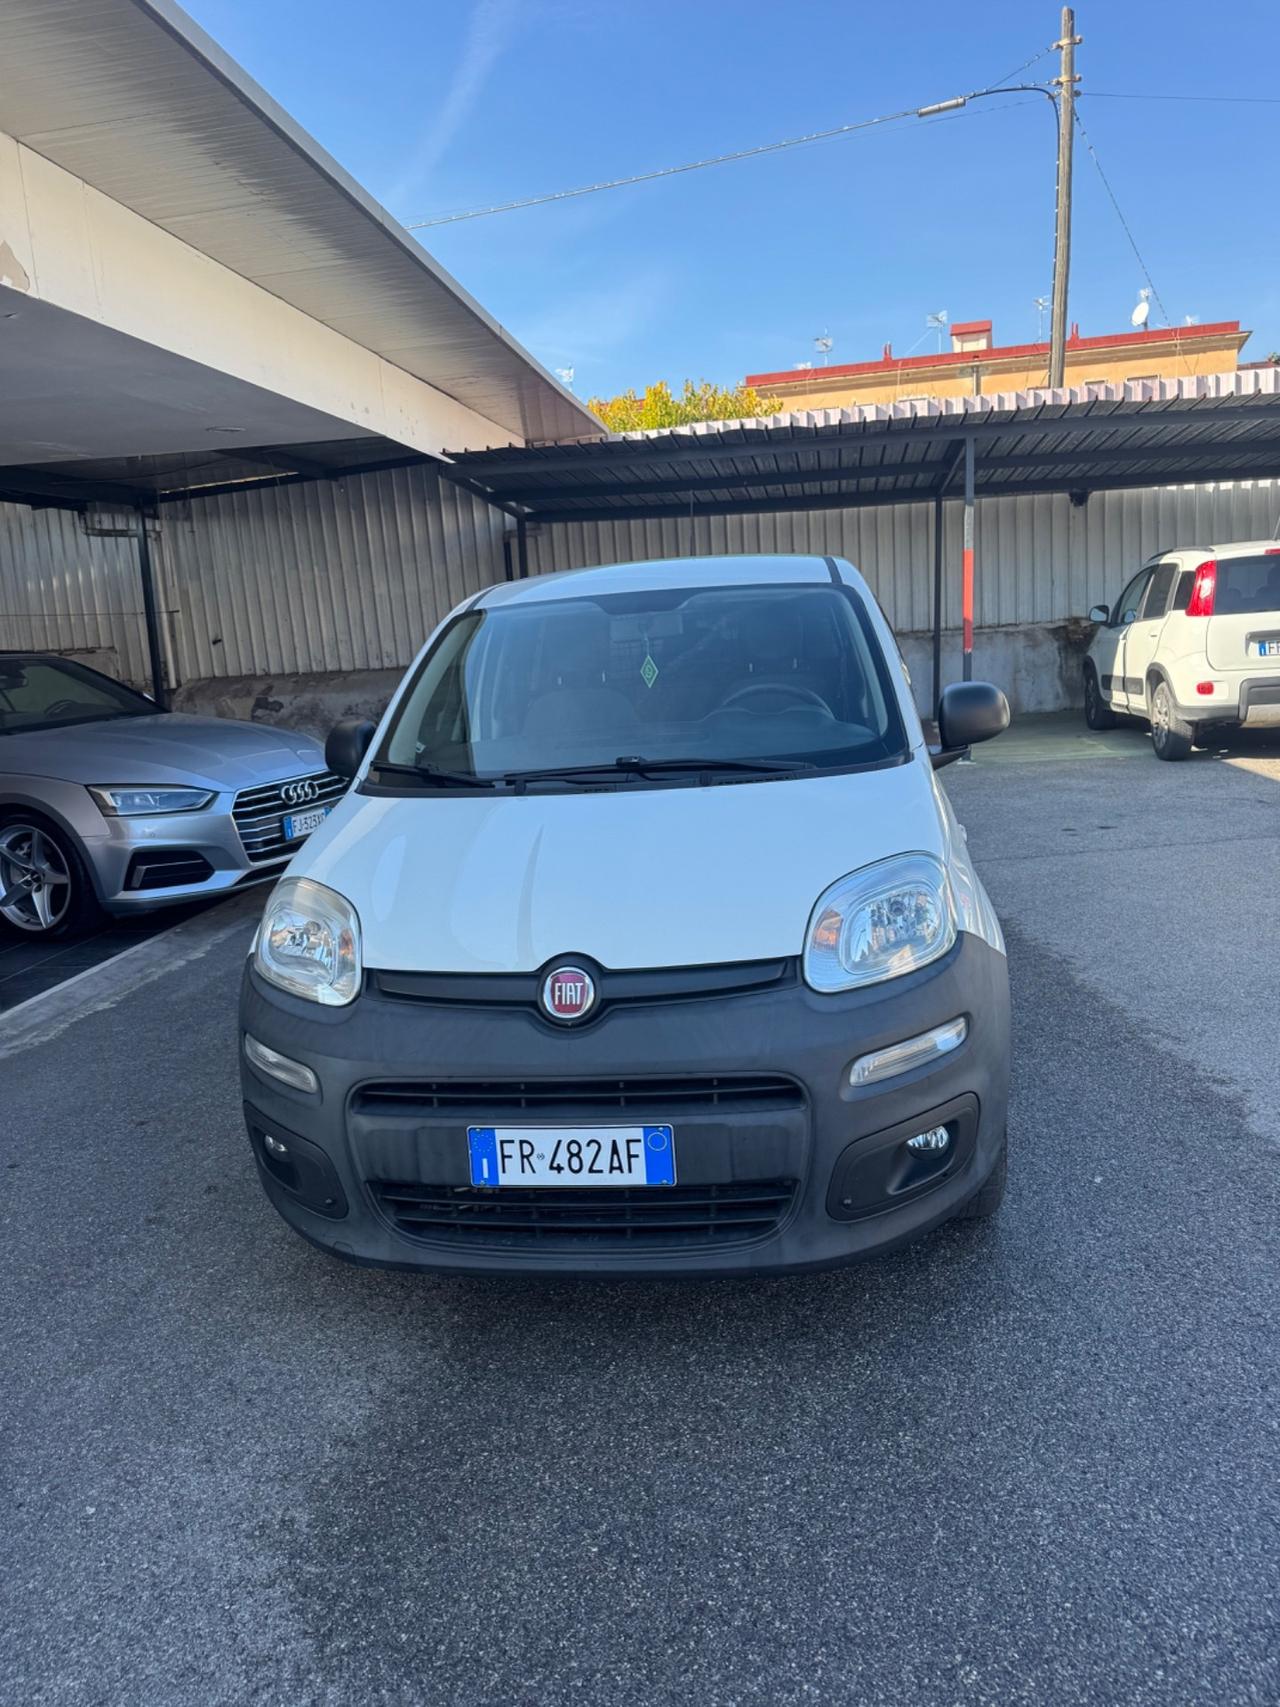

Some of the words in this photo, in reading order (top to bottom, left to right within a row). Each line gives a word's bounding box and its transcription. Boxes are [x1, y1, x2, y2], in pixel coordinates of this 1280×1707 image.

[554, 982, 584, 1005] FIAT
[499, 1139, 536, 1174] FR
[549, 1139, 642, 1174] 482AF
